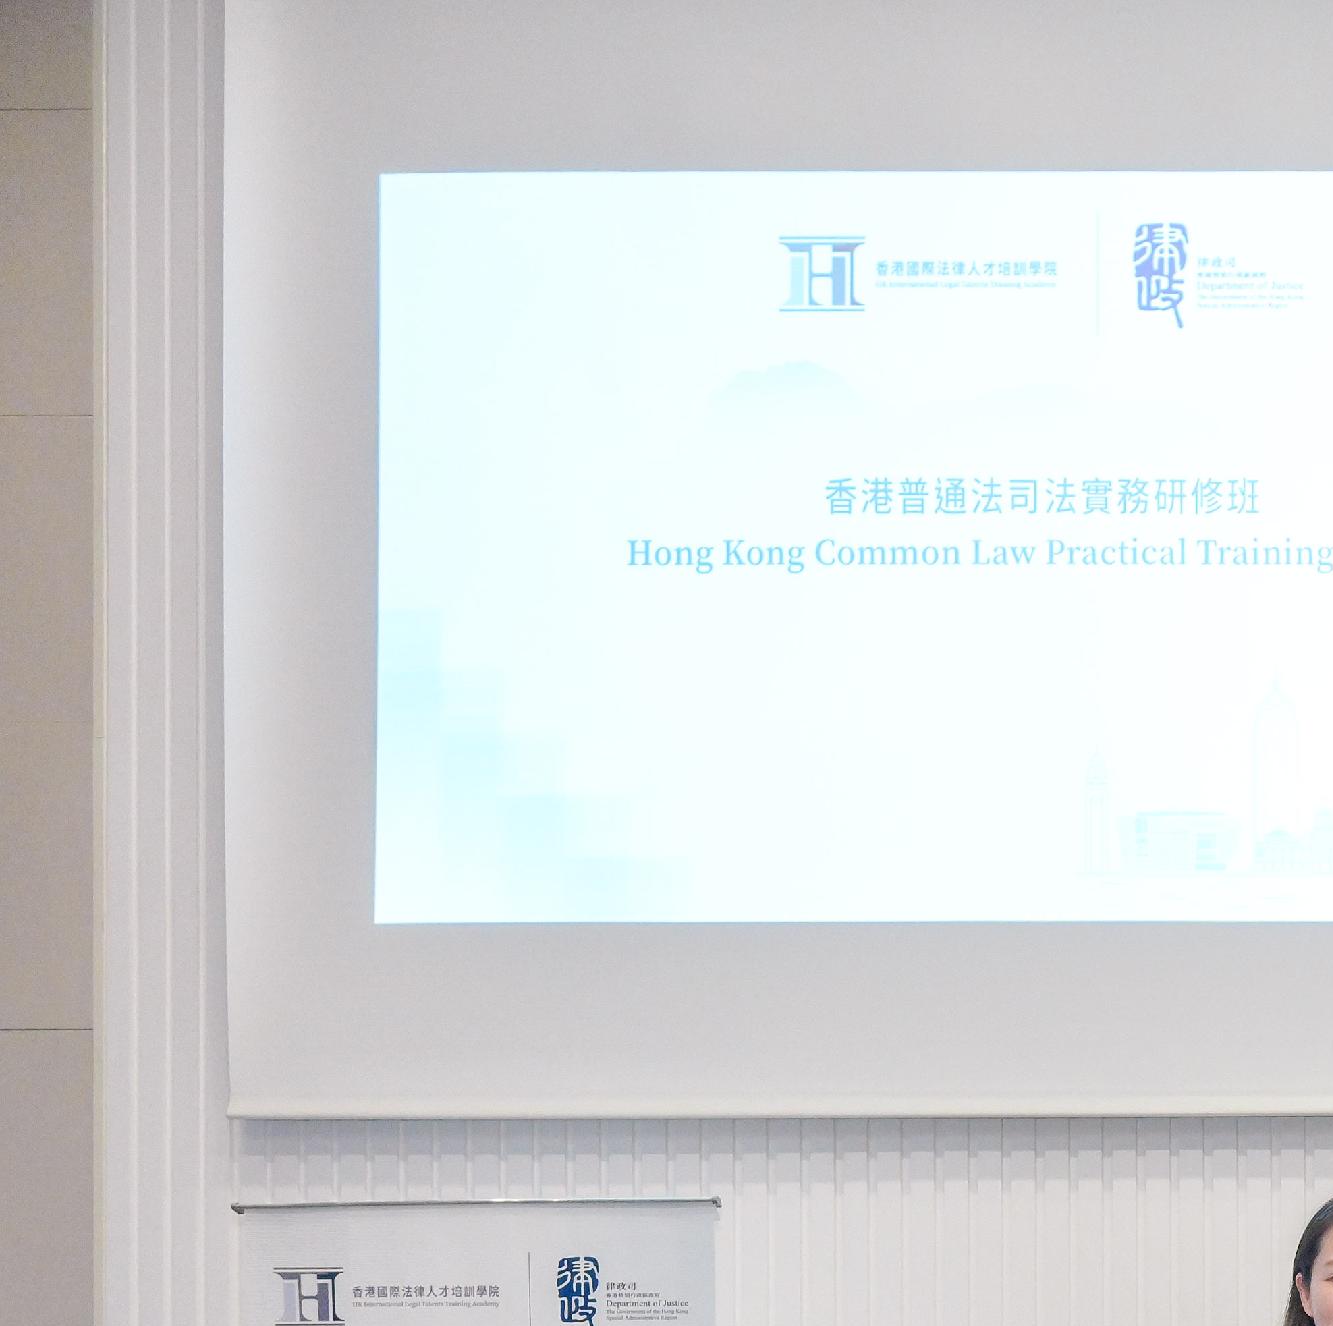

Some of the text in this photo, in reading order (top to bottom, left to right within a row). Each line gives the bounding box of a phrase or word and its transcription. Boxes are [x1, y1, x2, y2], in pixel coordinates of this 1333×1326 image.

[825, 477, 1258, 515] 香港普通法司法實務研修班
[627, 539, 714, 575] Hong
[723, 539, 805, 574] Kong
[814, 538, 960, 566] Common
[973, 539, 1036, 565] Law
[1047, 537, 1185, 565] Practical
[1197, 538, 1333, 573] Training
[352, 1284, 500, 1298] 香港國際法律人才培訓學院
[606, 1300, 651, 1309] Department
